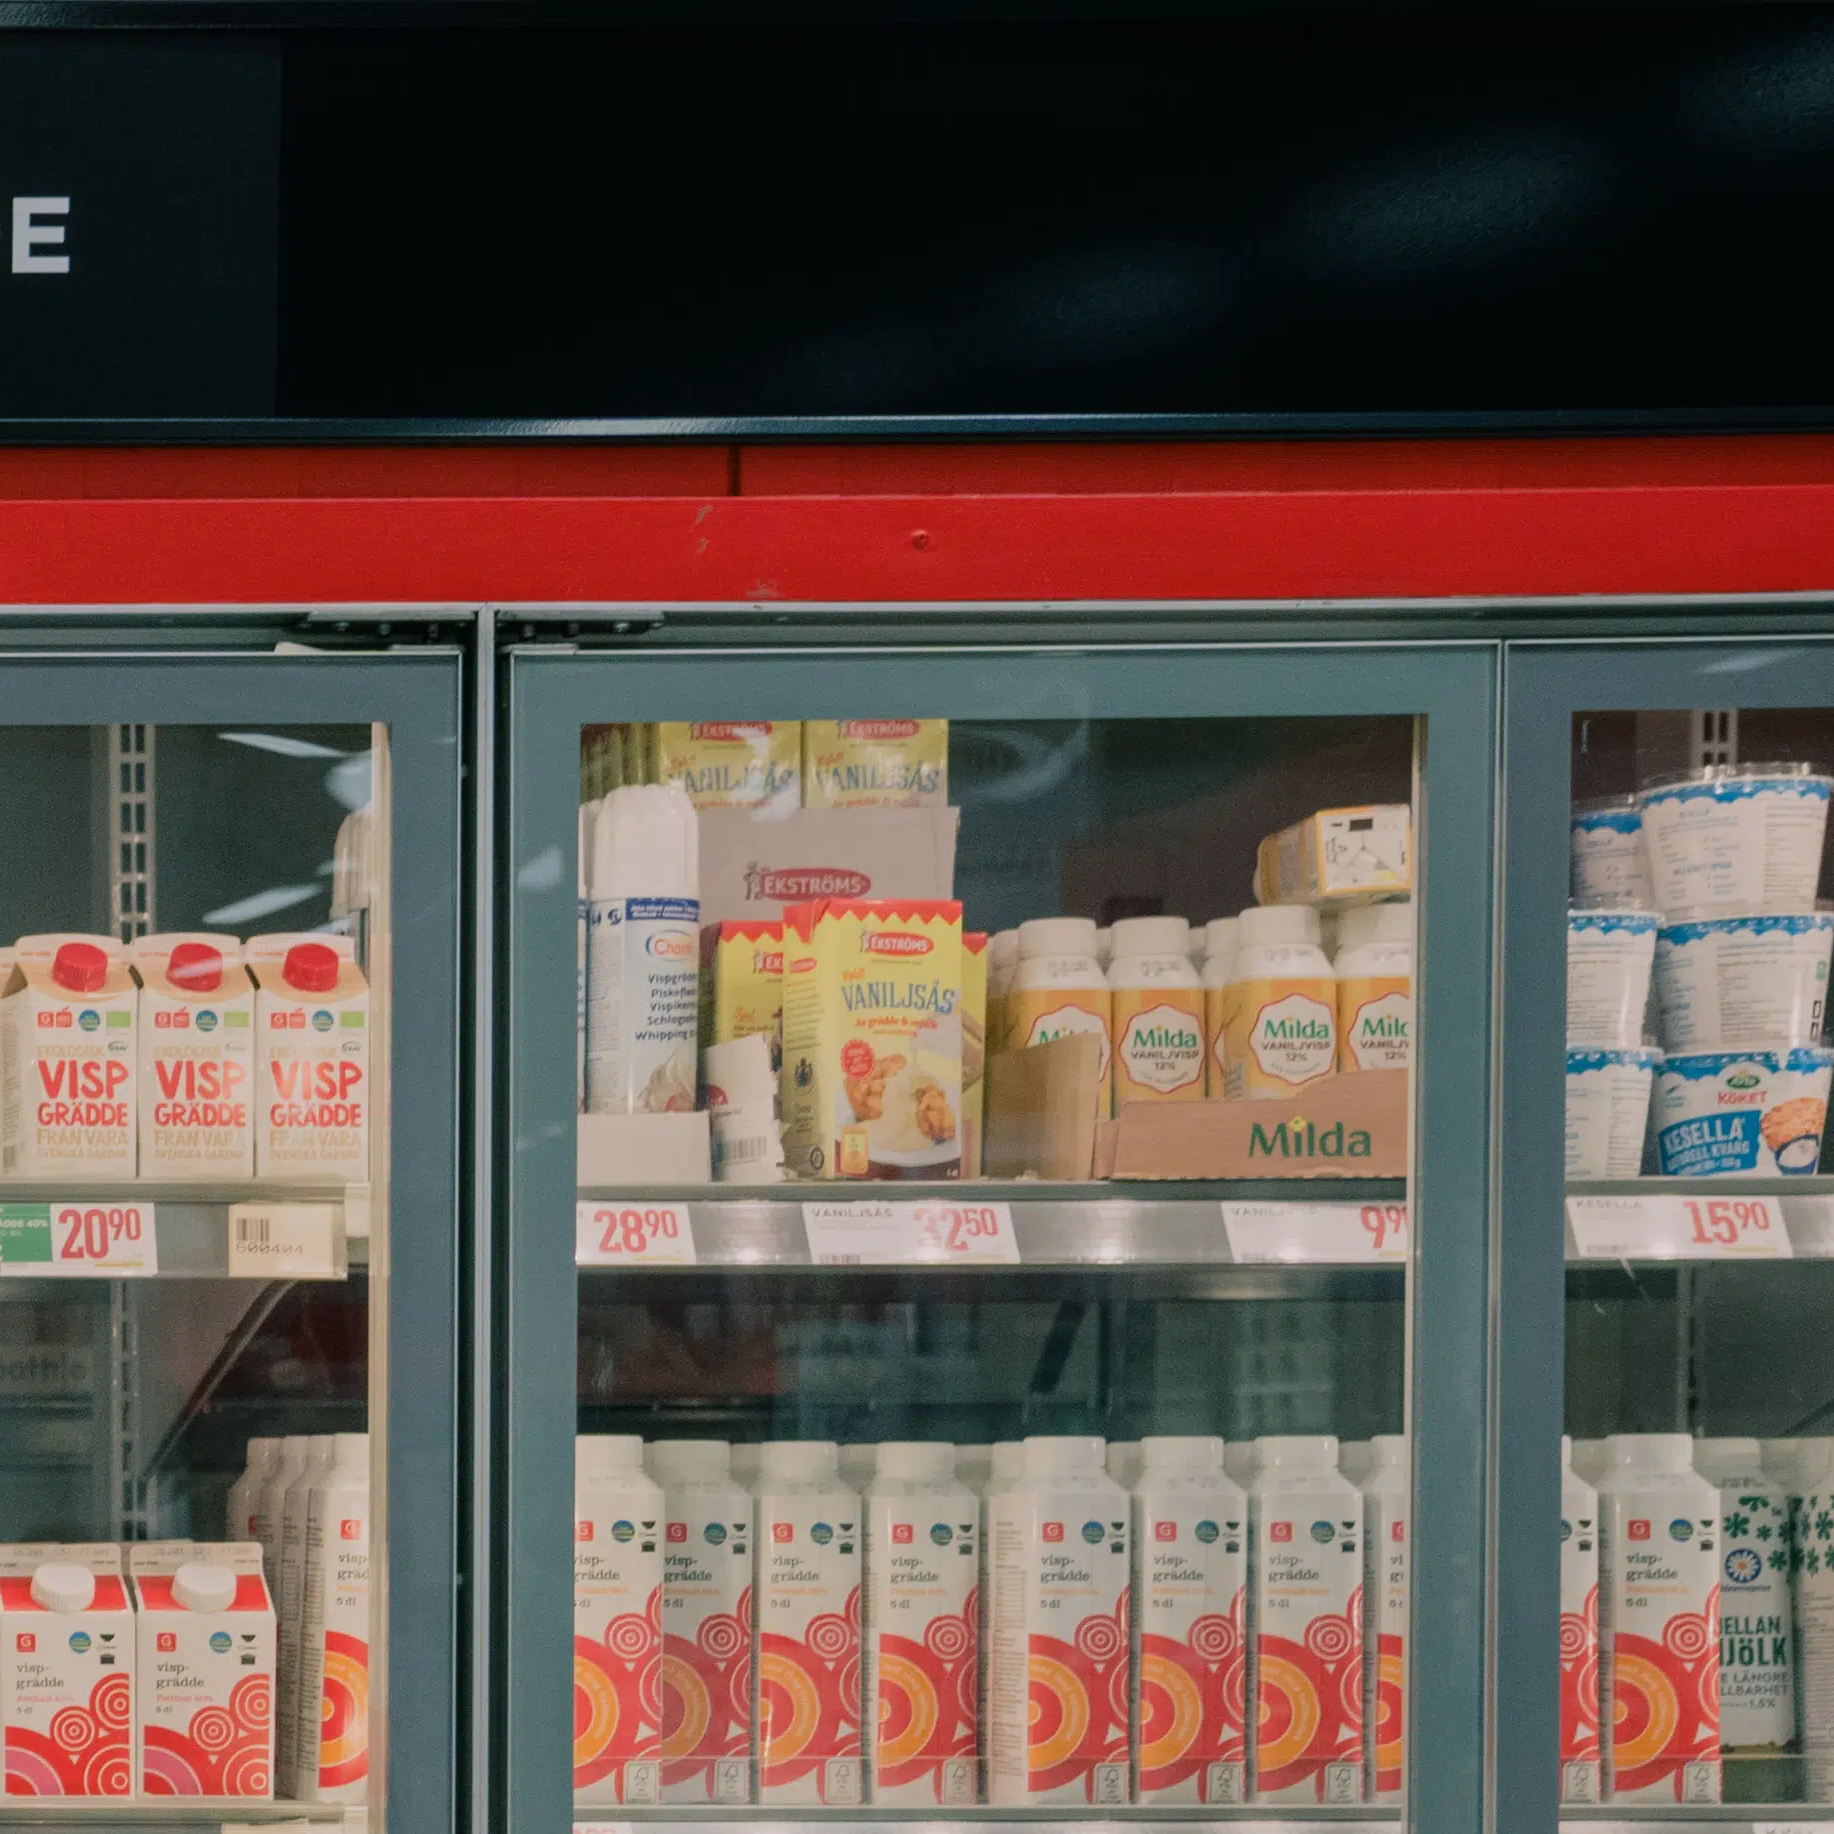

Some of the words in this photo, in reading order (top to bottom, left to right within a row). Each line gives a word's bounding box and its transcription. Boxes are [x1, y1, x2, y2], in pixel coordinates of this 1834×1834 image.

[764, 873, 863, 895] EKSTRÖMS
[871, 935, 928, 952] EKSTRÖMS
[842, 979, 955, 1014] VANILJSÅS
[1264, 1016, 1330, 1042] Milda
[38, 1059, 129, 1099] VISP
[38, 1101, 128, 1126] GRÄDDE
[1248, 1118, 1372, 1158] Milda
[58, 1208, 141, 1260] 2090
[594, 1207, 678, 1252] 2890
[1683, 1200, 1769, 1245] 1590
[1040, 1570, 1090, 1584] grädde
[156, 1662, 189, 1674] visp-
[156, 1675, 205, 1689] grädde
